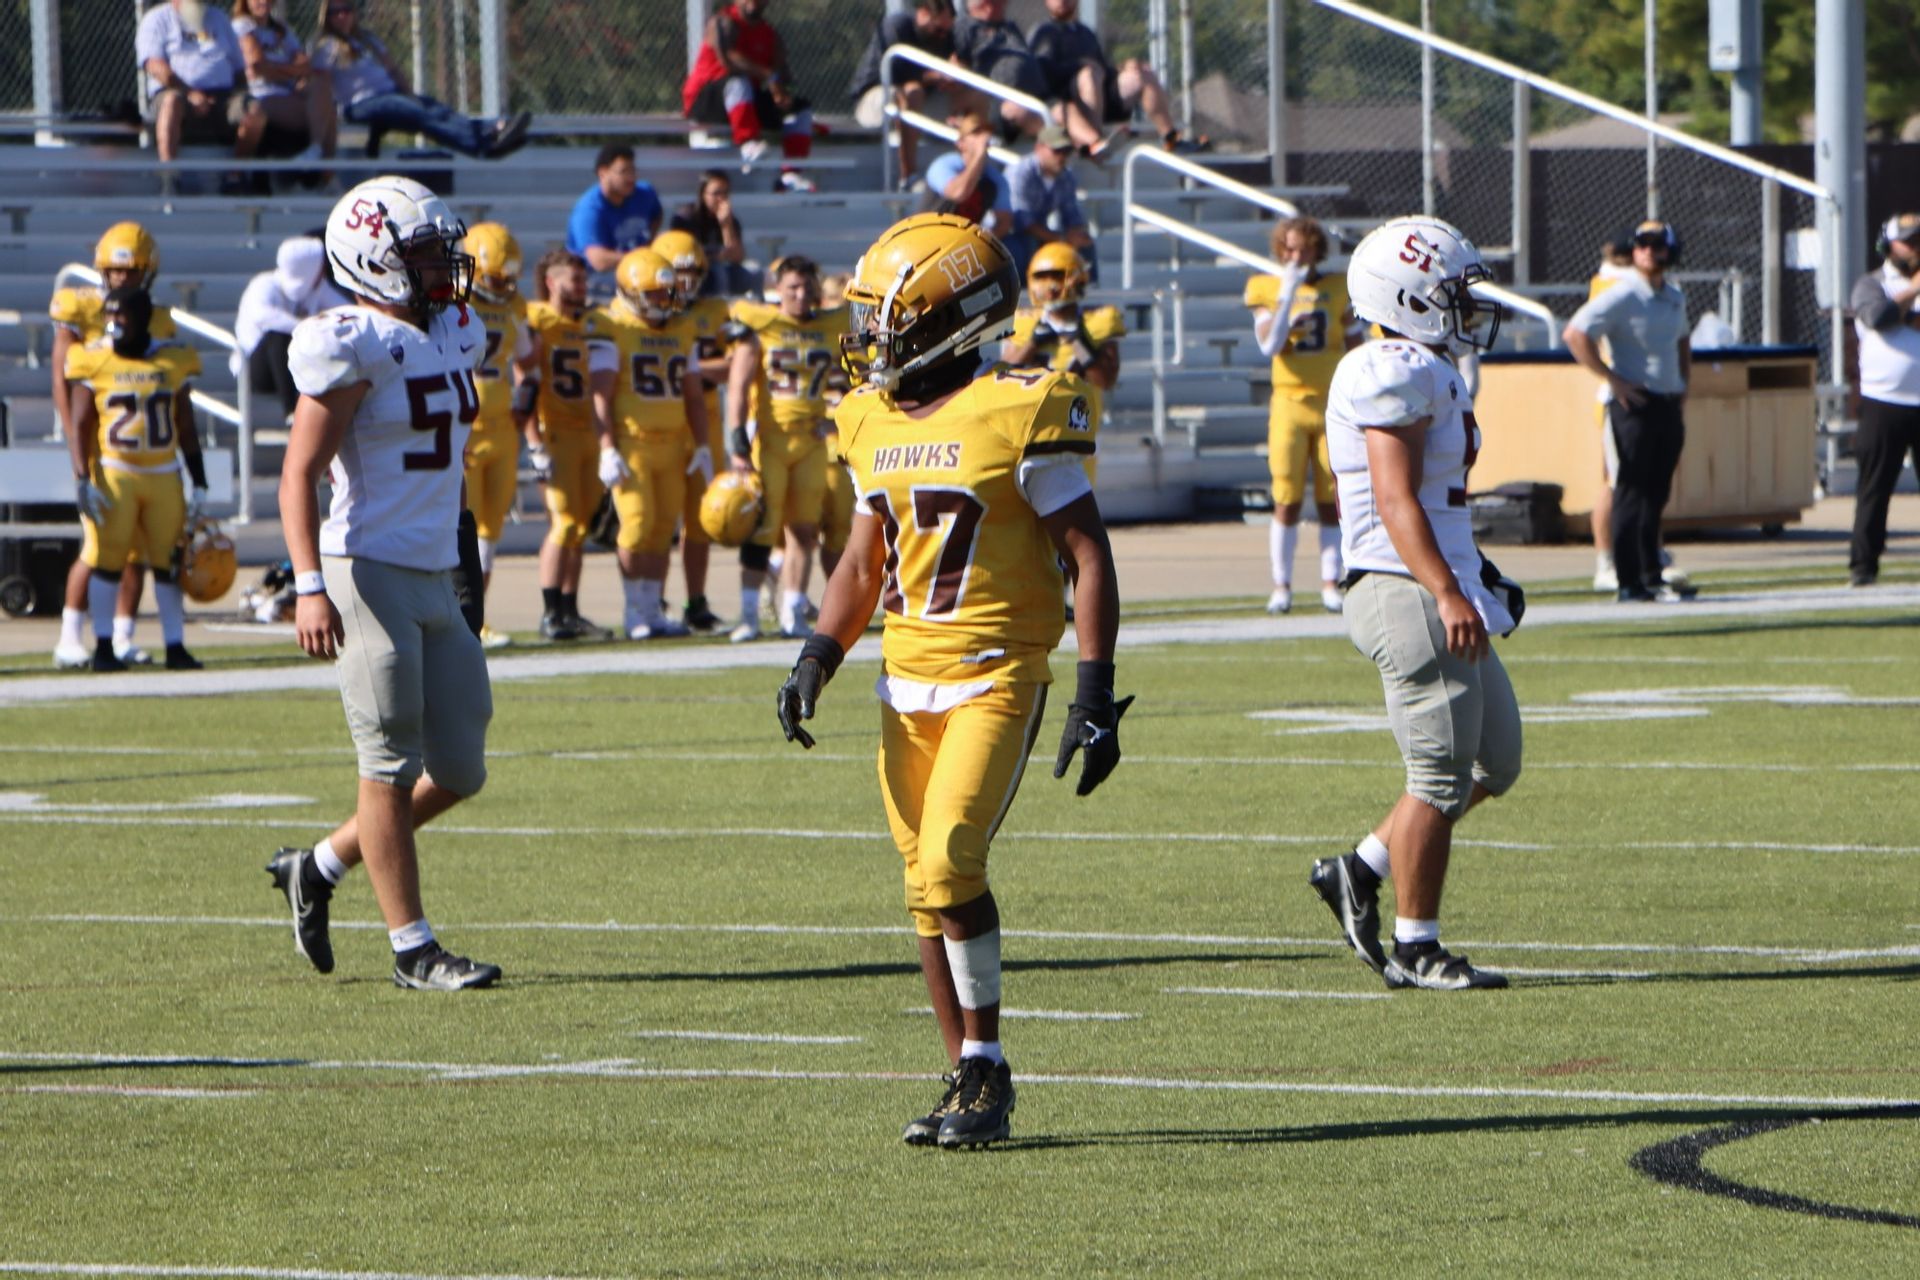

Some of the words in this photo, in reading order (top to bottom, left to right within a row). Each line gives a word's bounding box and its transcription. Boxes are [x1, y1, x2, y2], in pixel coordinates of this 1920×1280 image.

[346, 199, 383, 238] 54
[937, 242, 986, 293] 17
[552, 346, 584, 399] 5
[767, 347, 832, 399] 57
[106, 389, 175, 450] 20
[873, 442, 961, 476] HAWKS
[865, 484, 989, 623] 17
